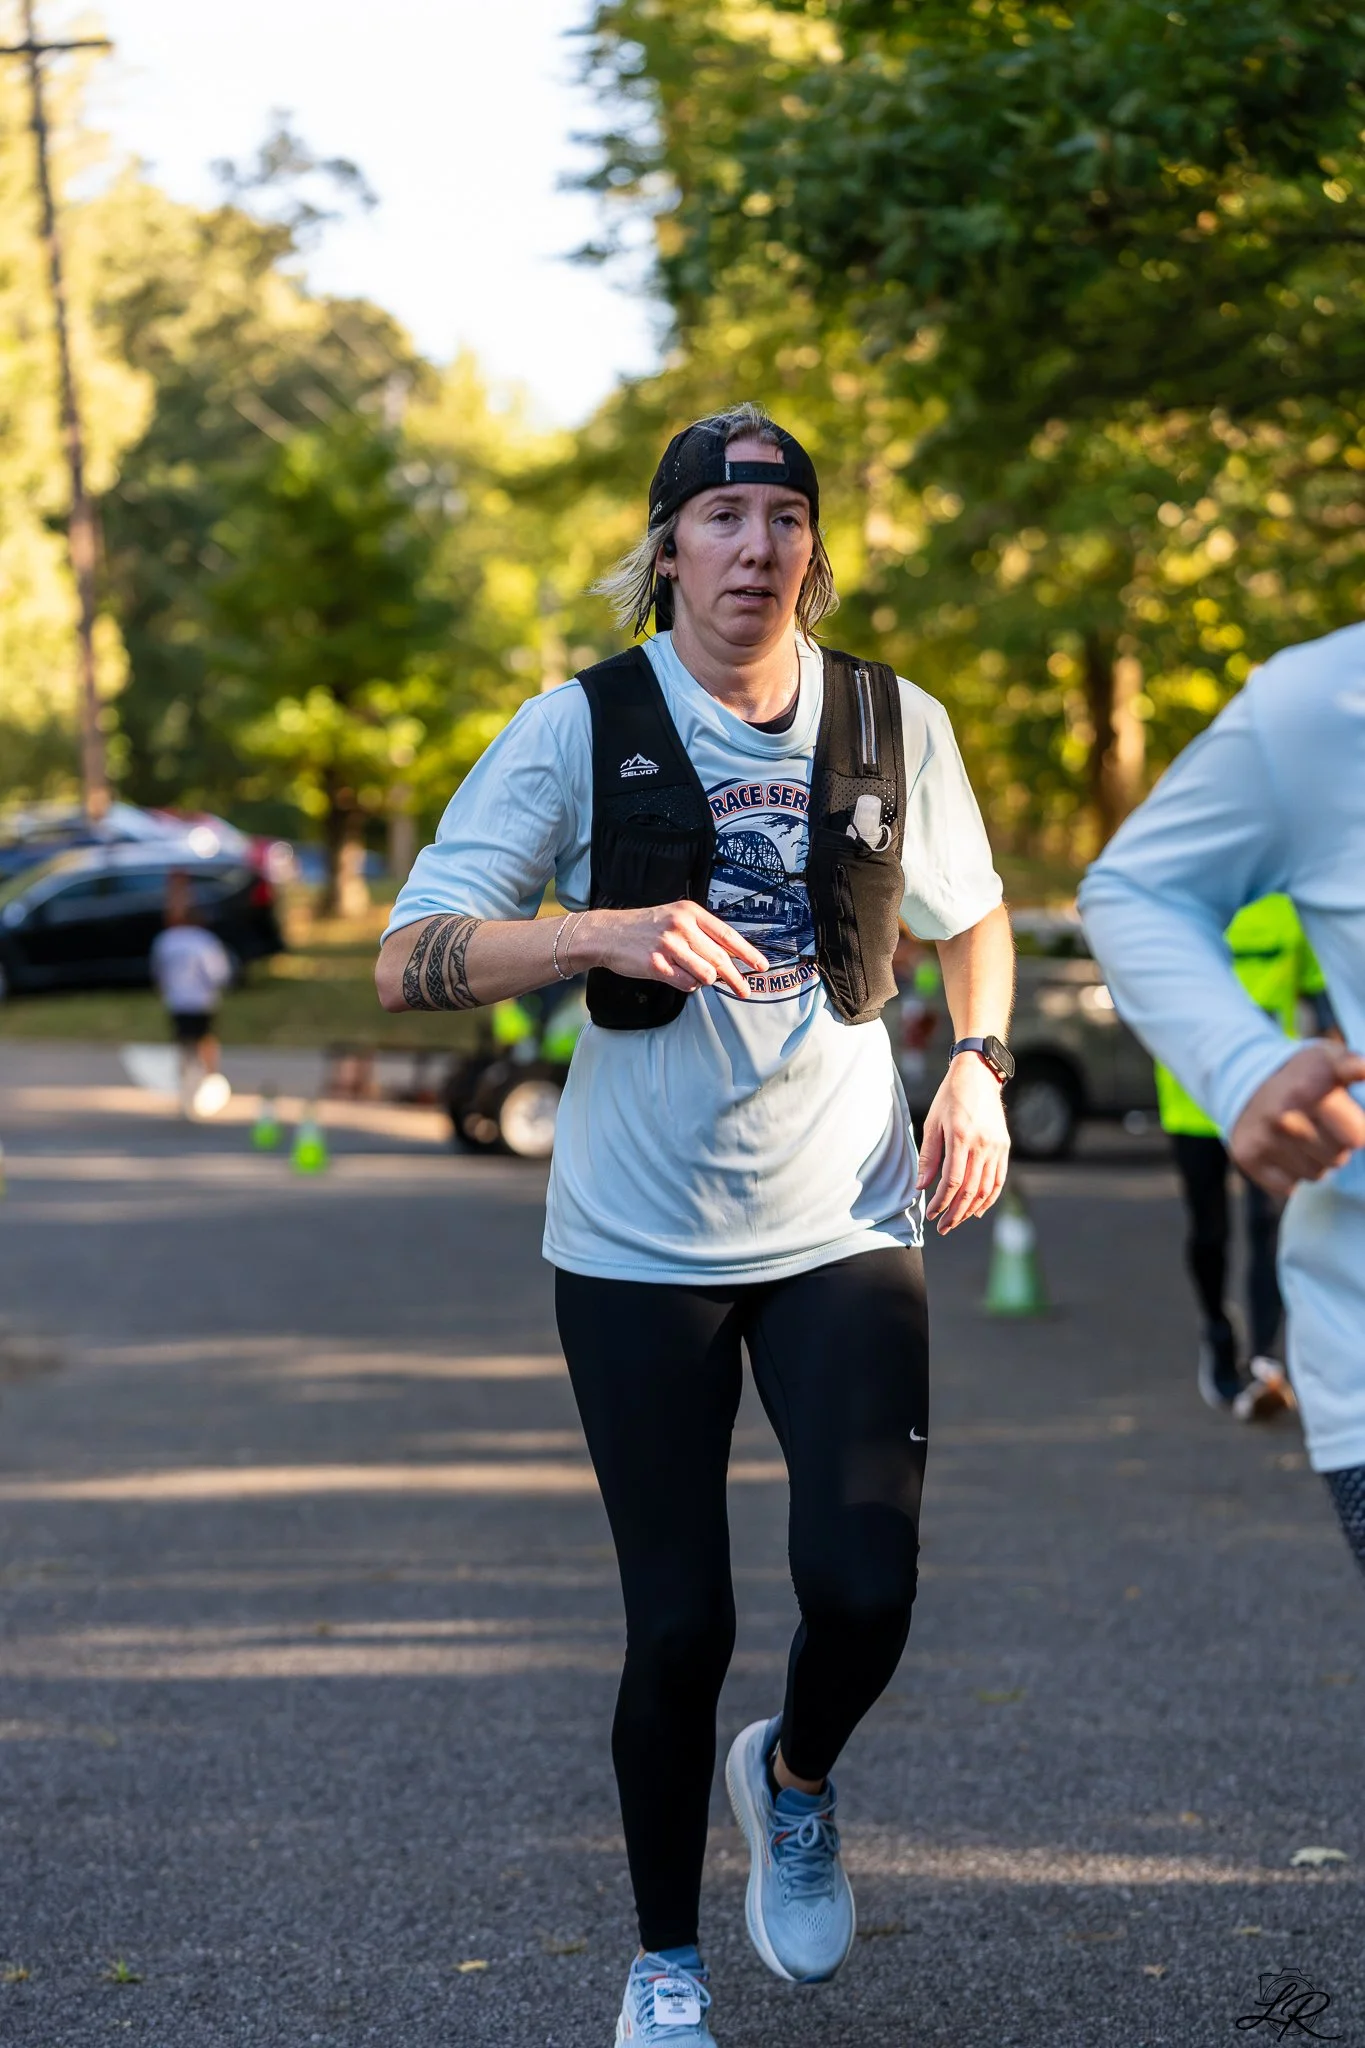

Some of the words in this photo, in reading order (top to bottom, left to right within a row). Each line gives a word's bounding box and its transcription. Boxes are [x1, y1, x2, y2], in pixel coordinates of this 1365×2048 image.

[708, 783, 764, 820] RACE
[767, 782, 809, 814] SER
[742, 973, 766, 992] ER
[768, 962, 818, 992] MEMOR
